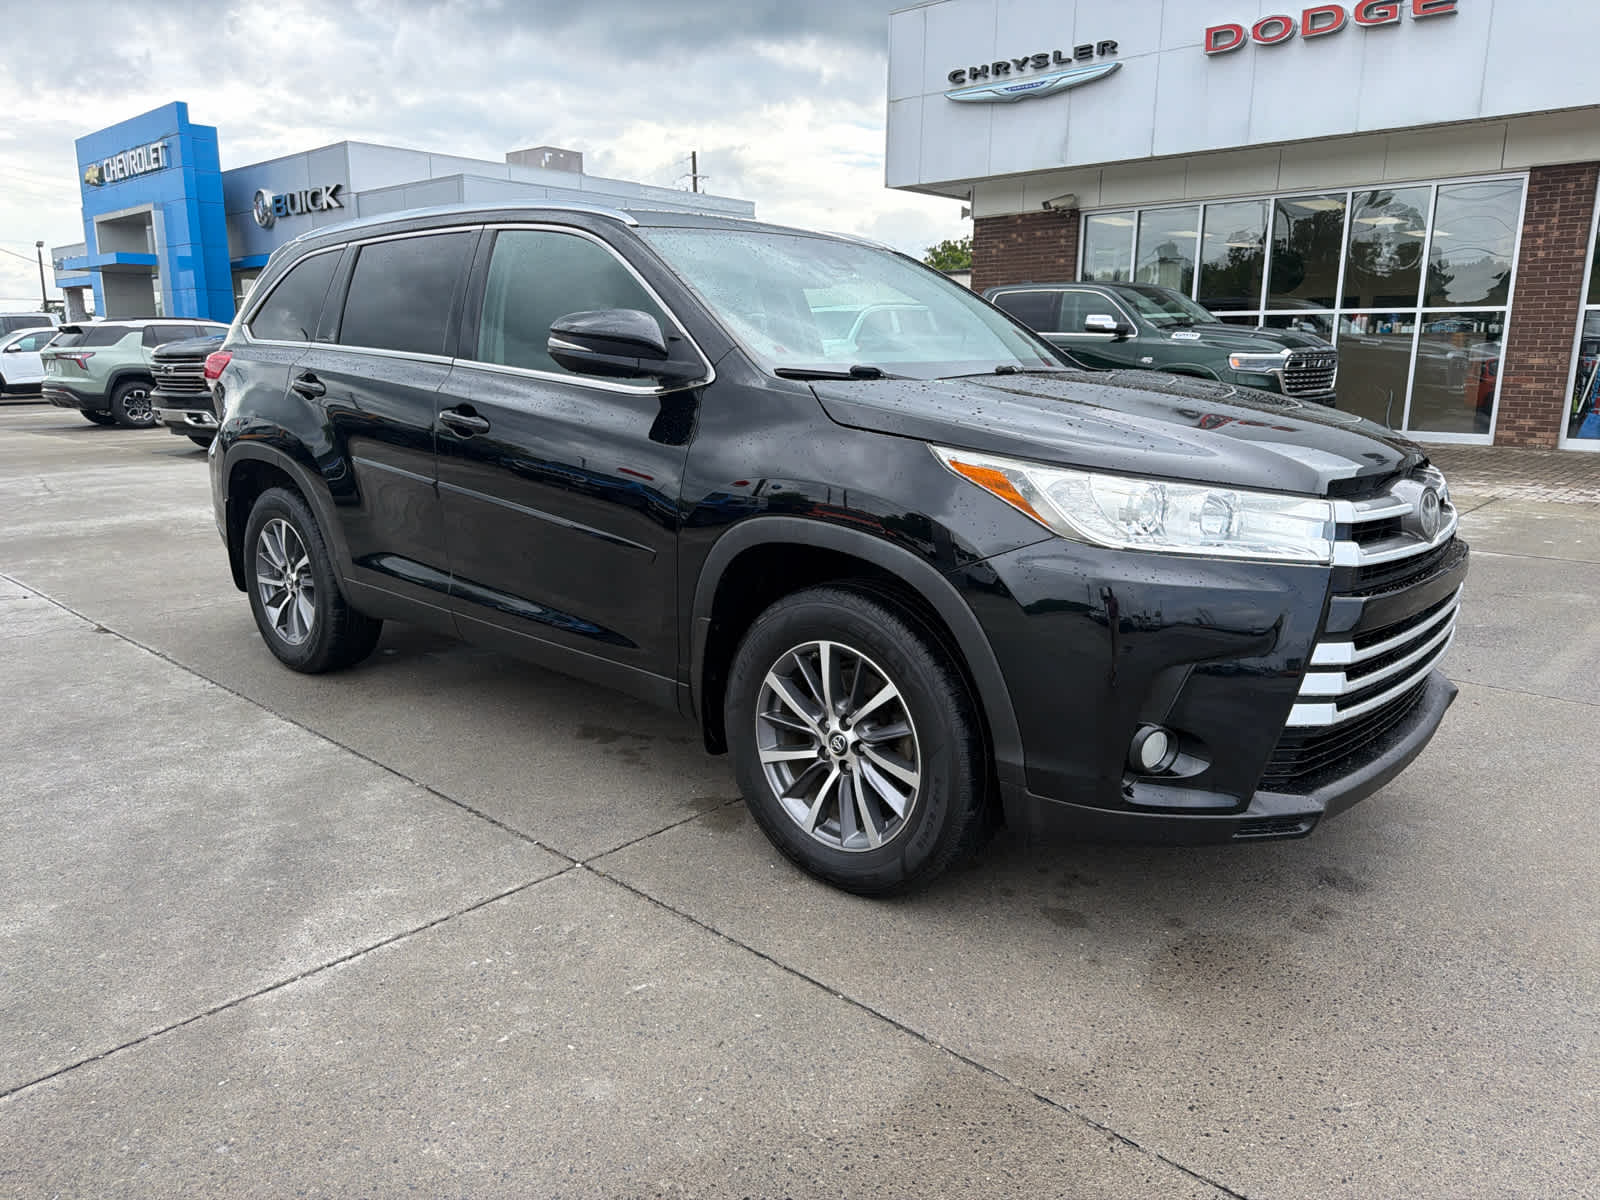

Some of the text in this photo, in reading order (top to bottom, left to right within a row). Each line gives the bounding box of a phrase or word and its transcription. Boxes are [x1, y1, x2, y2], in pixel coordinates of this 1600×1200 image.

[948, 39, 1119, 84] CHRYSLER
[103, 141, 167, 182] CHEVROLET
[272, 184, 344, 217] BUICK
